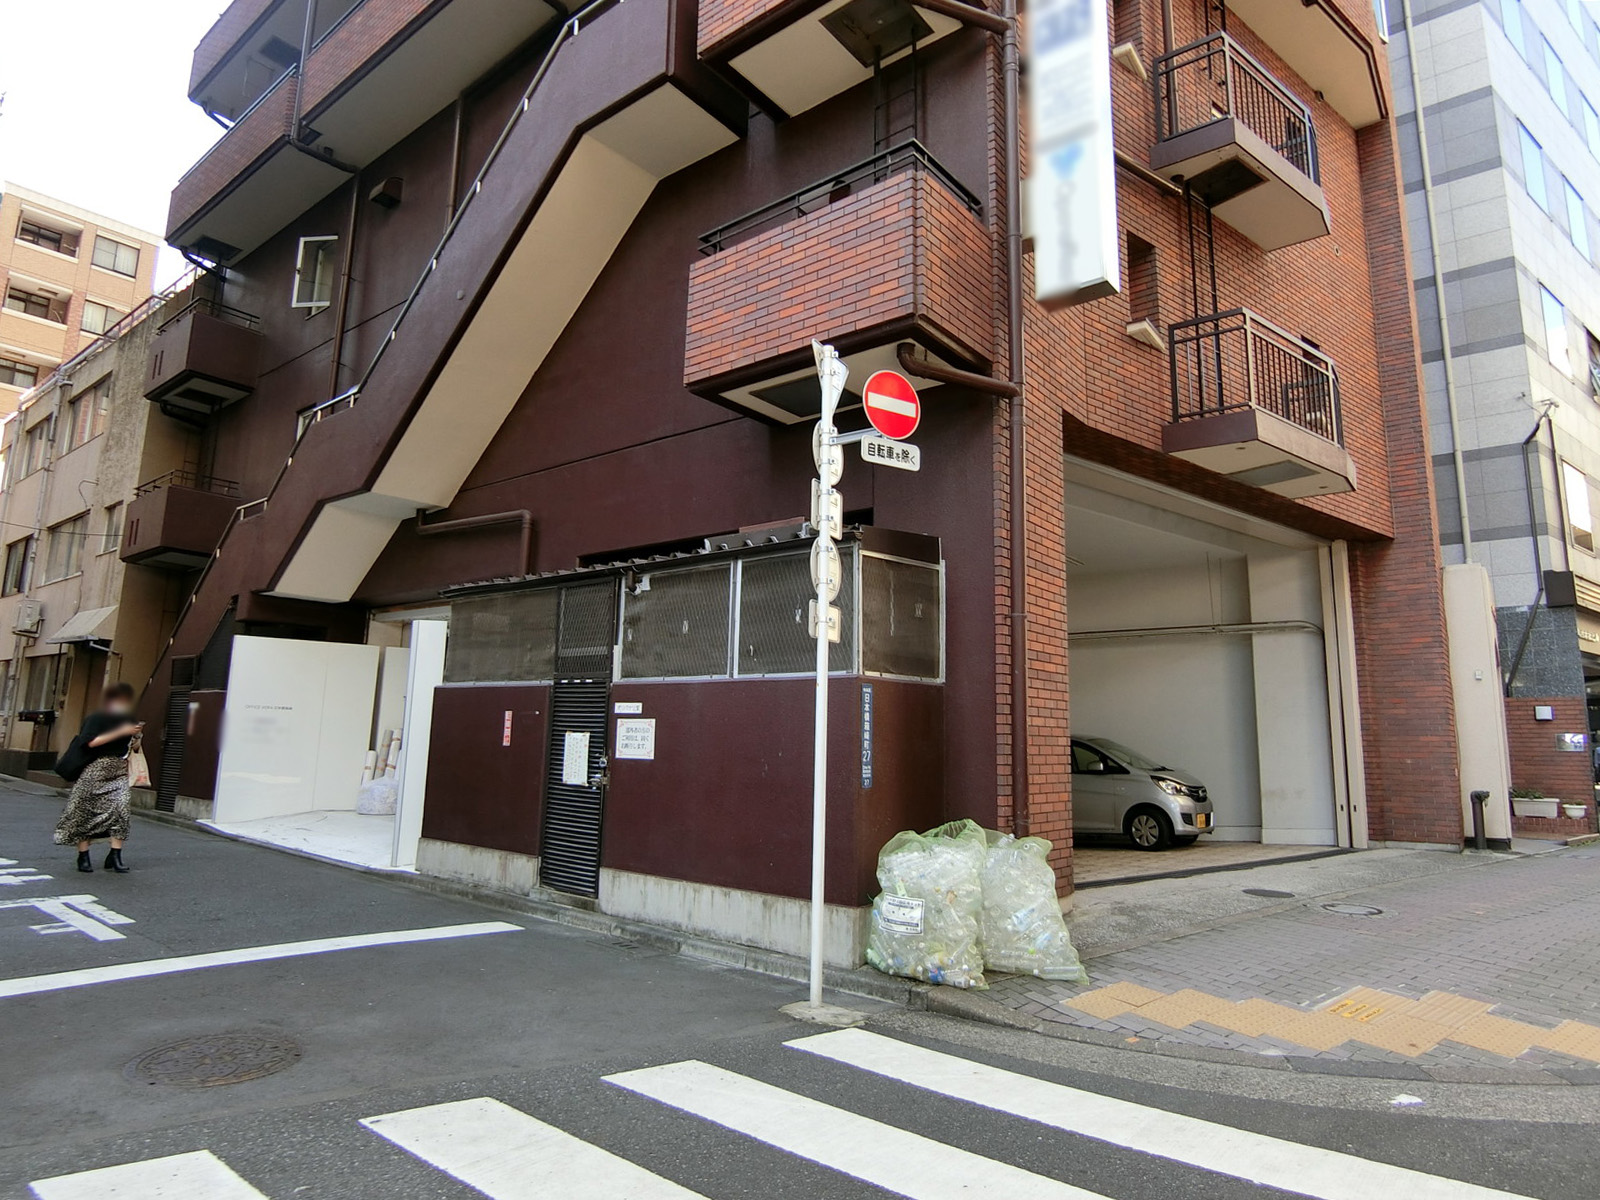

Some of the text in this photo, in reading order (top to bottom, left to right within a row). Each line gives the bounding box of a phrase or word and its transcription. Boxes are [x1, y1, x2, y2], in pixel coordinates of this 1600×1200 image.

[867, 442, 916, 465] 自転車を除く
[862, 750, 870, 762] 27
